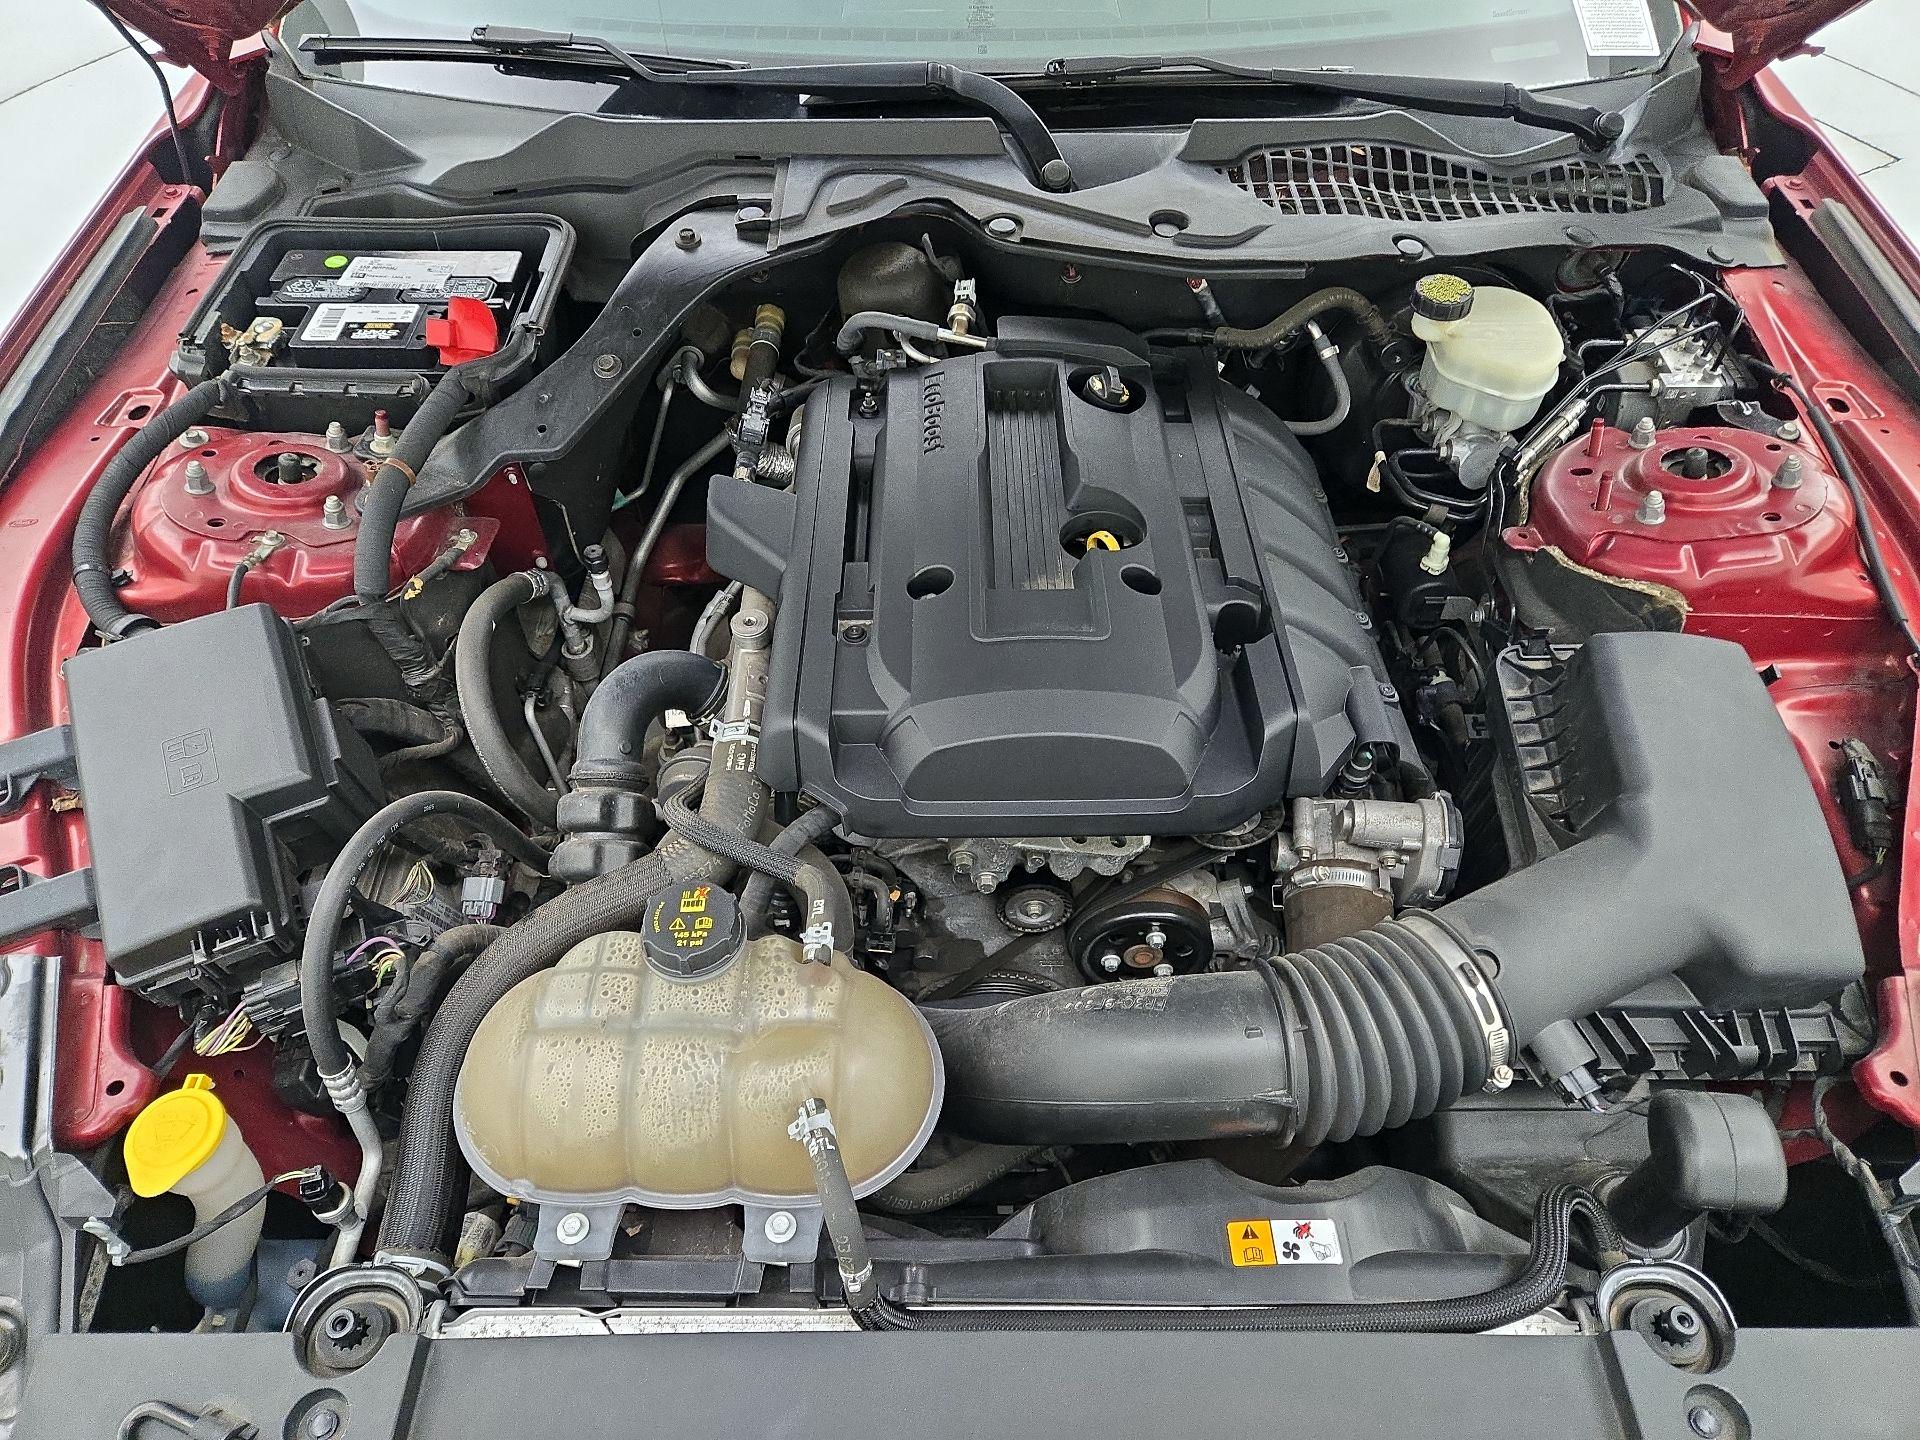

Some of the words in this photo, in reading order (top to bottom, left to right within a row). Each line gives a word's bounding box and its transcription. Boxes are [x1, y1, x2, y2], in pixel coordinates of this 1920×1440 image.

[923, 371, 946, 456] EcoBoost
[734, 752, 747, 771] ENG
[673, 931, 690, 939] 145
[689, 939, 703, 948] psi
